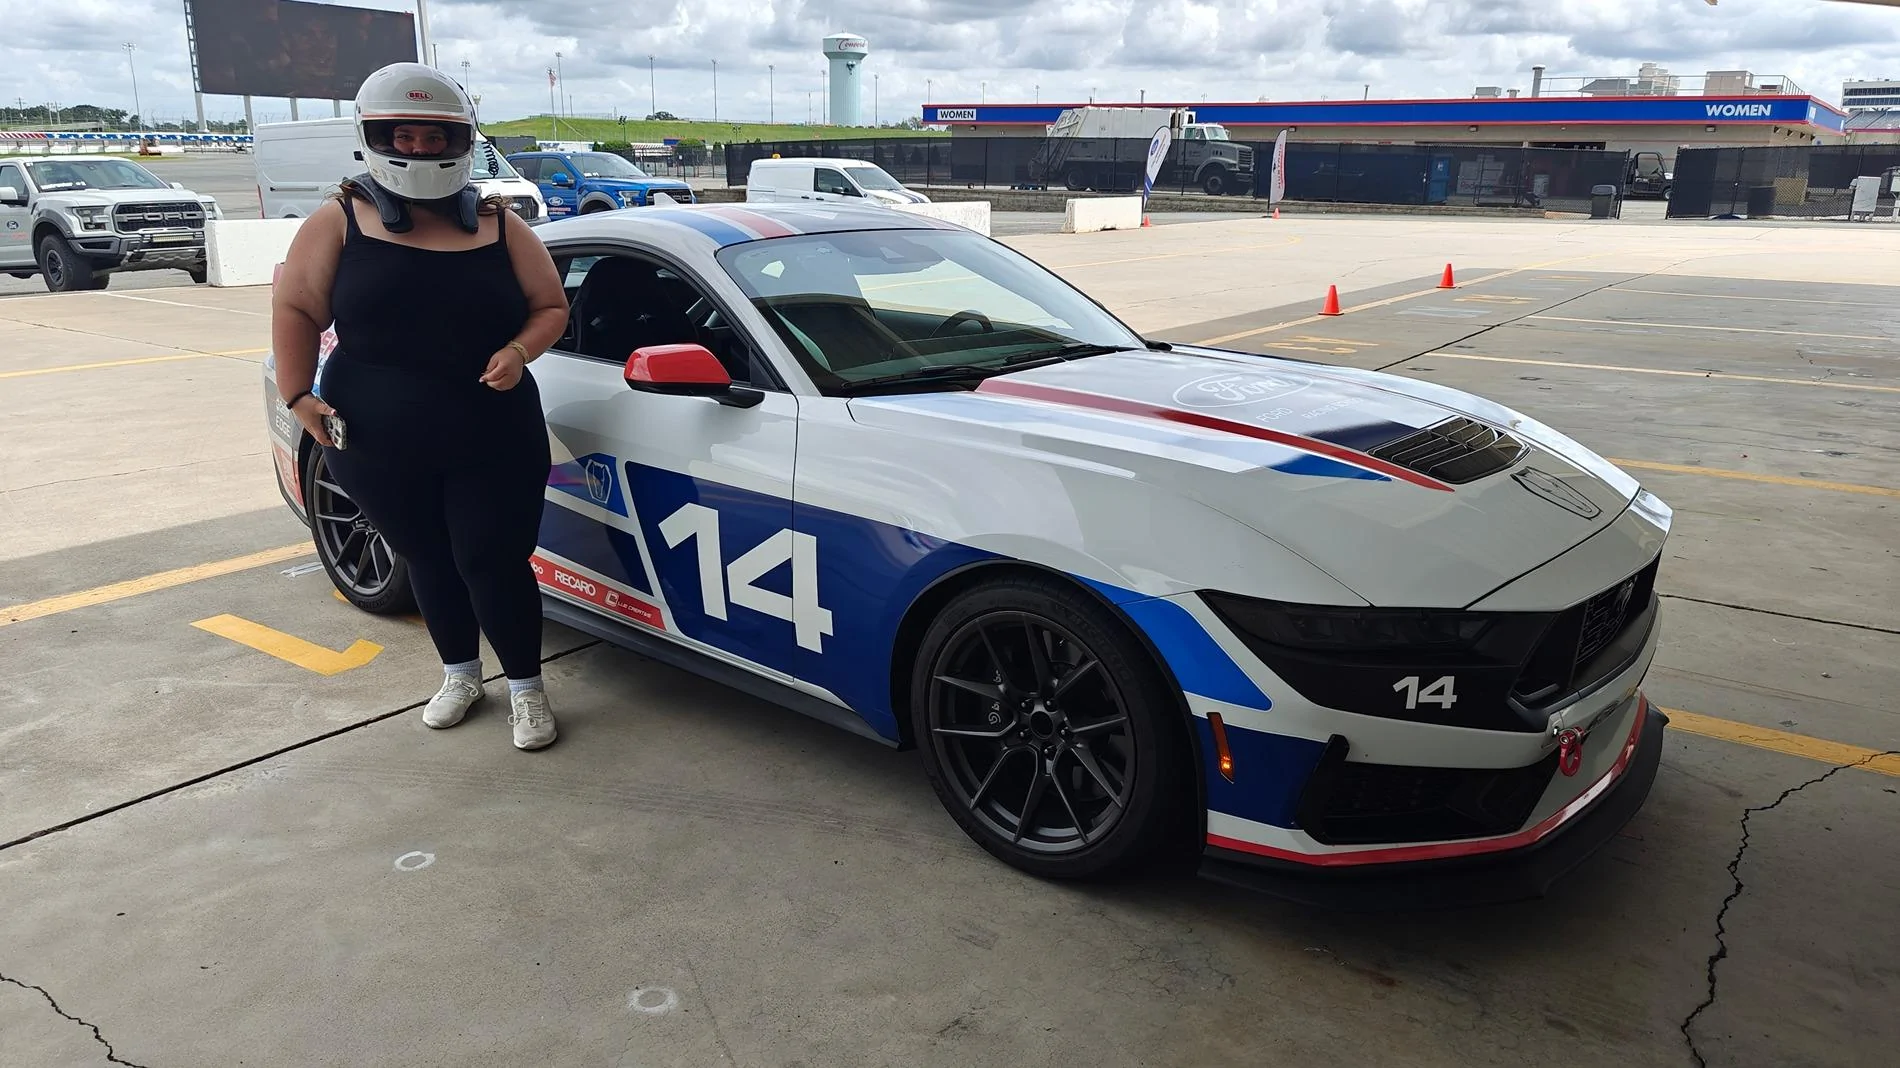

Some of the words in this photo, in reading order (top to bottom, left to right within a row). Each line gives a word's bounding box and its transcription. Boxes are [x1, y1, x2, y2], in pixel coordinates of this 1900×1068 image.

[940, 110, 974, 119] WOMEN
[1705, 104, 1772, 117] WOMEN
[122, 211, 201, 223] FORD
[1197, 376, 1297, 400] Ford
[1256, 407, 1293, 423] FORD
[555, 570, 596, 596] RECARO
[658, 502, 833, 654] 14
[1392, 676, 1457, 709] 14
